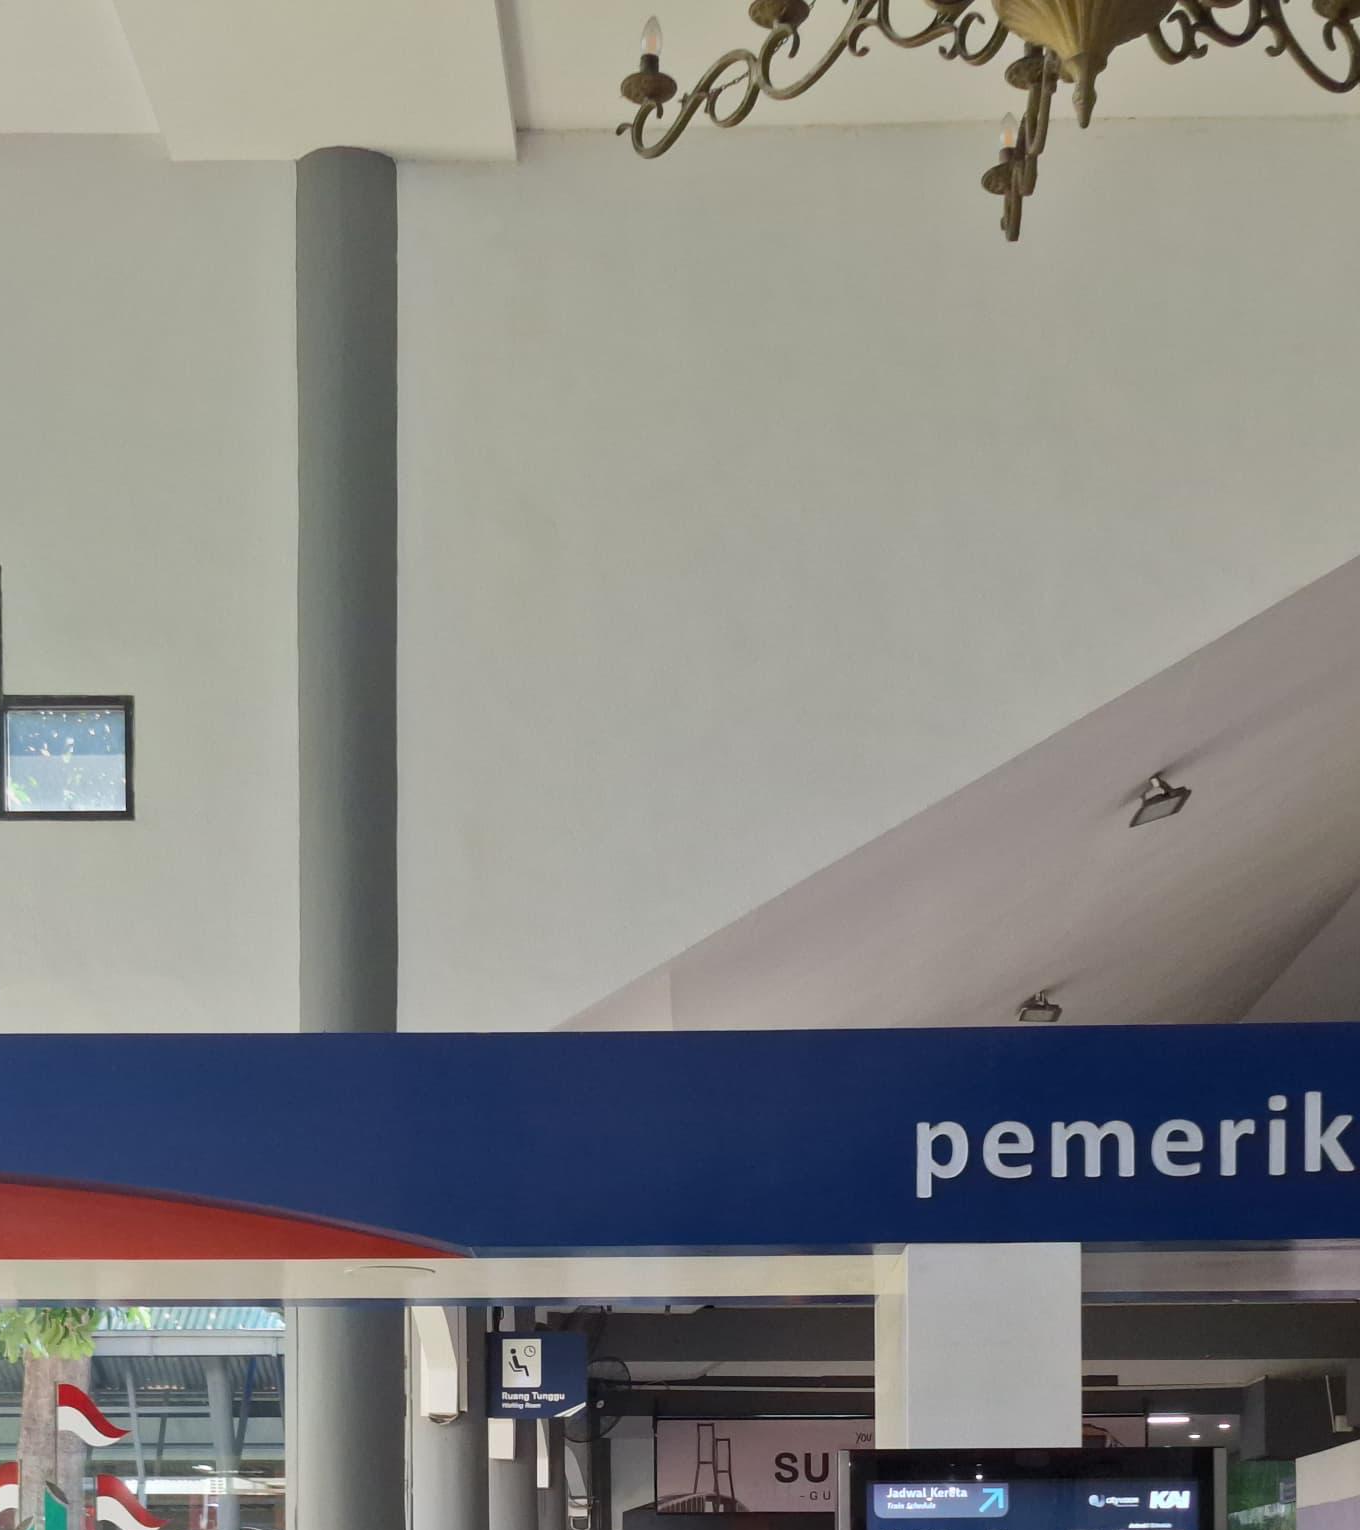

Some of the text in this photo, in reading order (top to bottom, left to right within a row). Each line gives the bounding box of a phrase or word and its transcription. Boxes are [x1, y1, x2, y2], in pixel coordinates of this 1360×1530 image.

[501, 1391, 566, 1402] Ruang Tunggu
[886, 1487, 969, 1499] Jadwal Kereta
[1149, 1490, 1191, 1509] KAI
